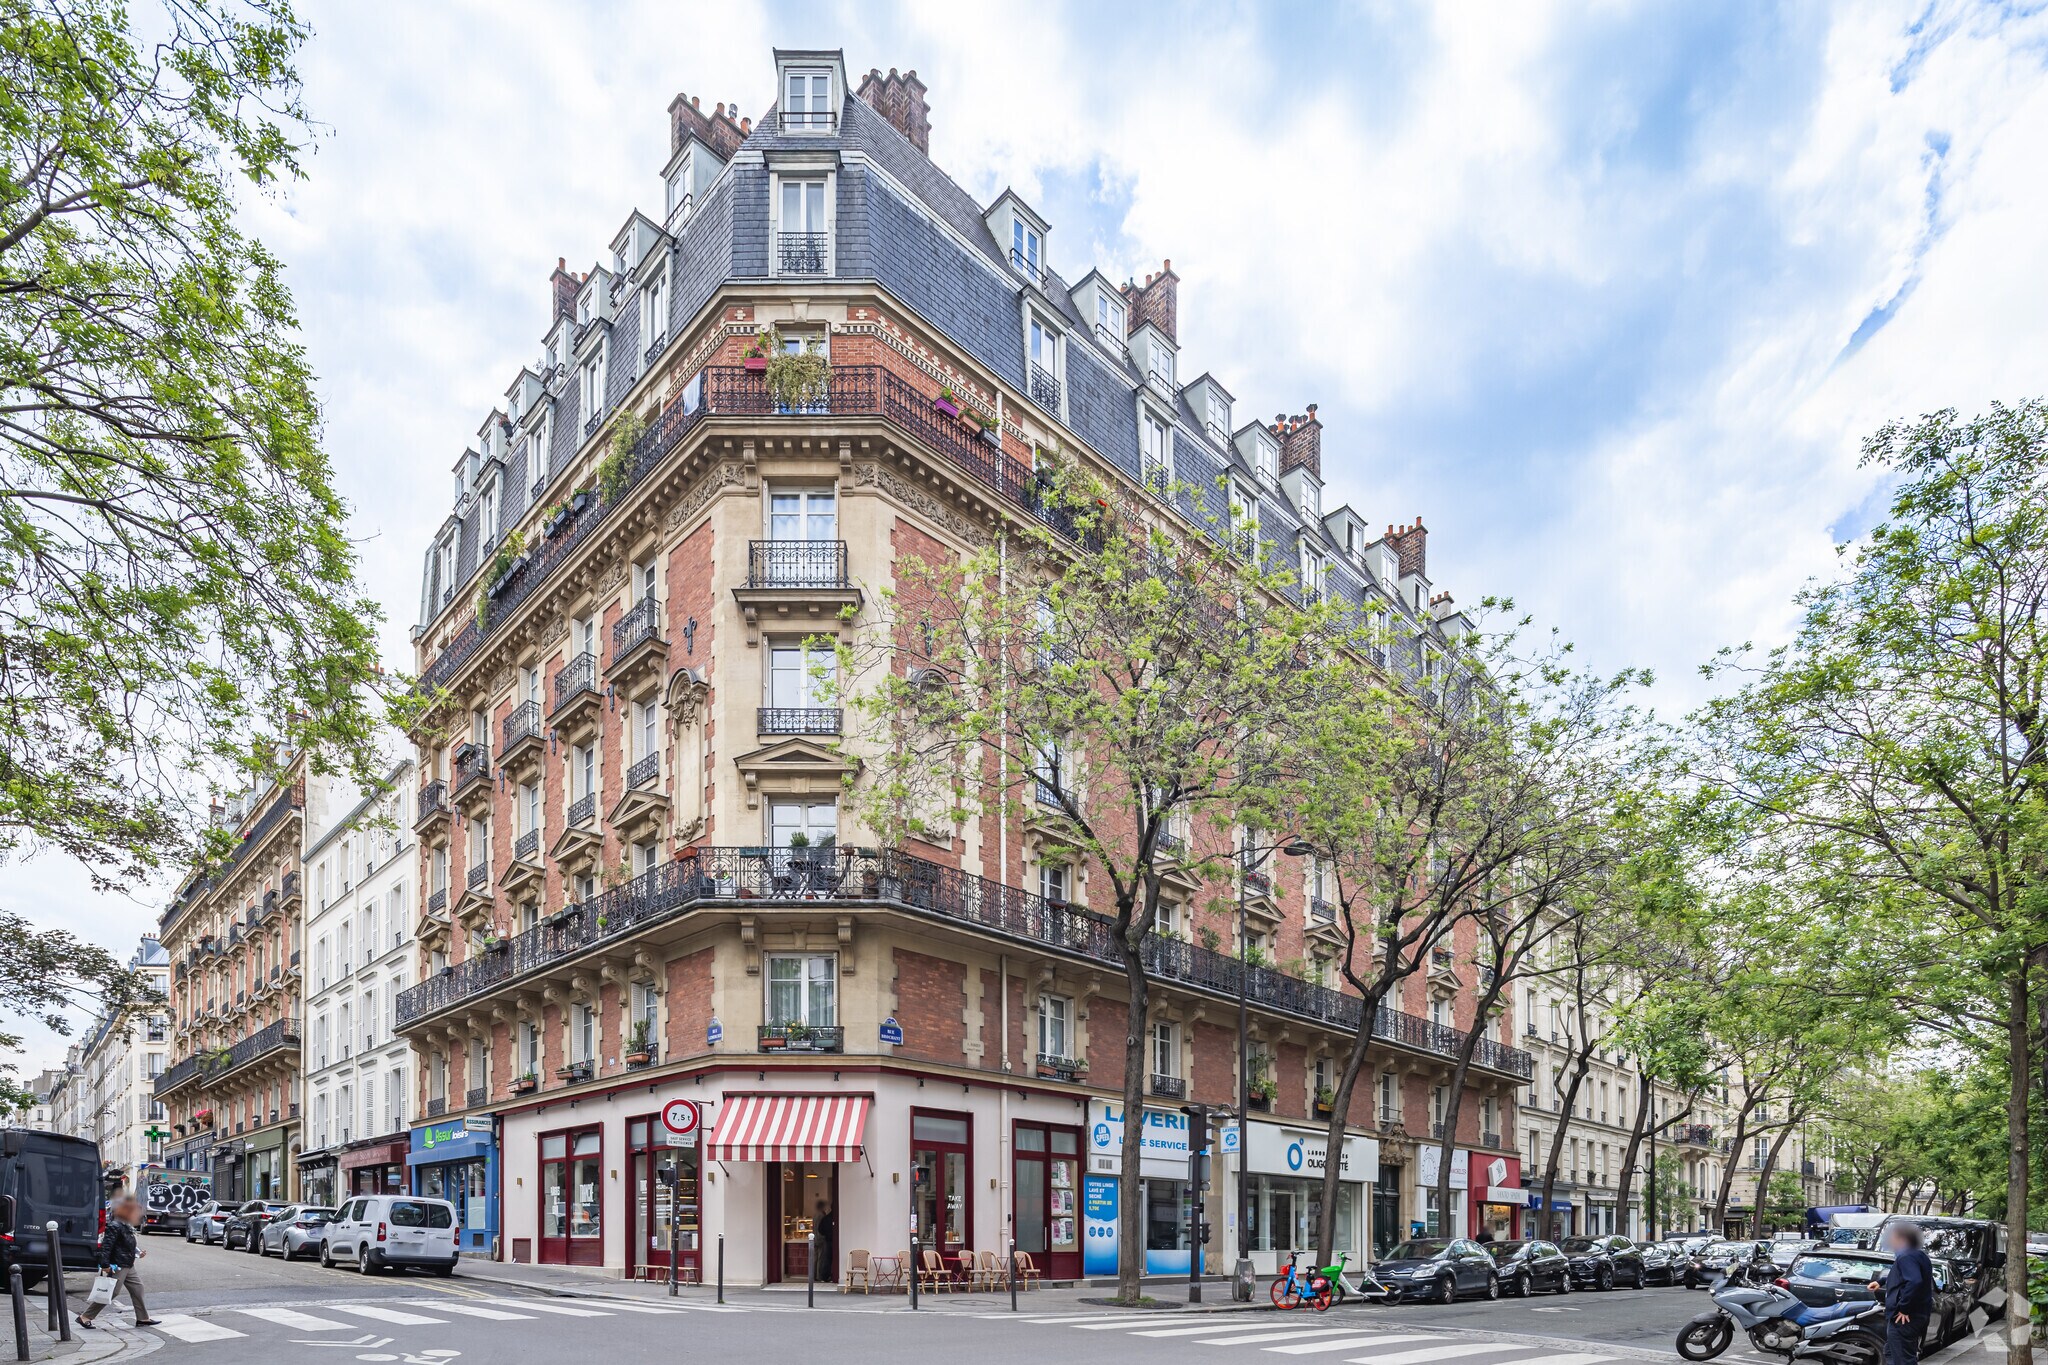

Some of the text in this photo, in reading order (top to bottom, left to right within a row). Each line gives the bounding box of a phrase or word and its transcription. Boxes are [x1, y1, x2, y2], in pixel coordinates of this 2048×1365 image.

[672, 1112, 686, 1122] 7,5
[452, 1130, 469, 1140] loisirs
[1149, 1138, 1187, 1151] SERVICE
